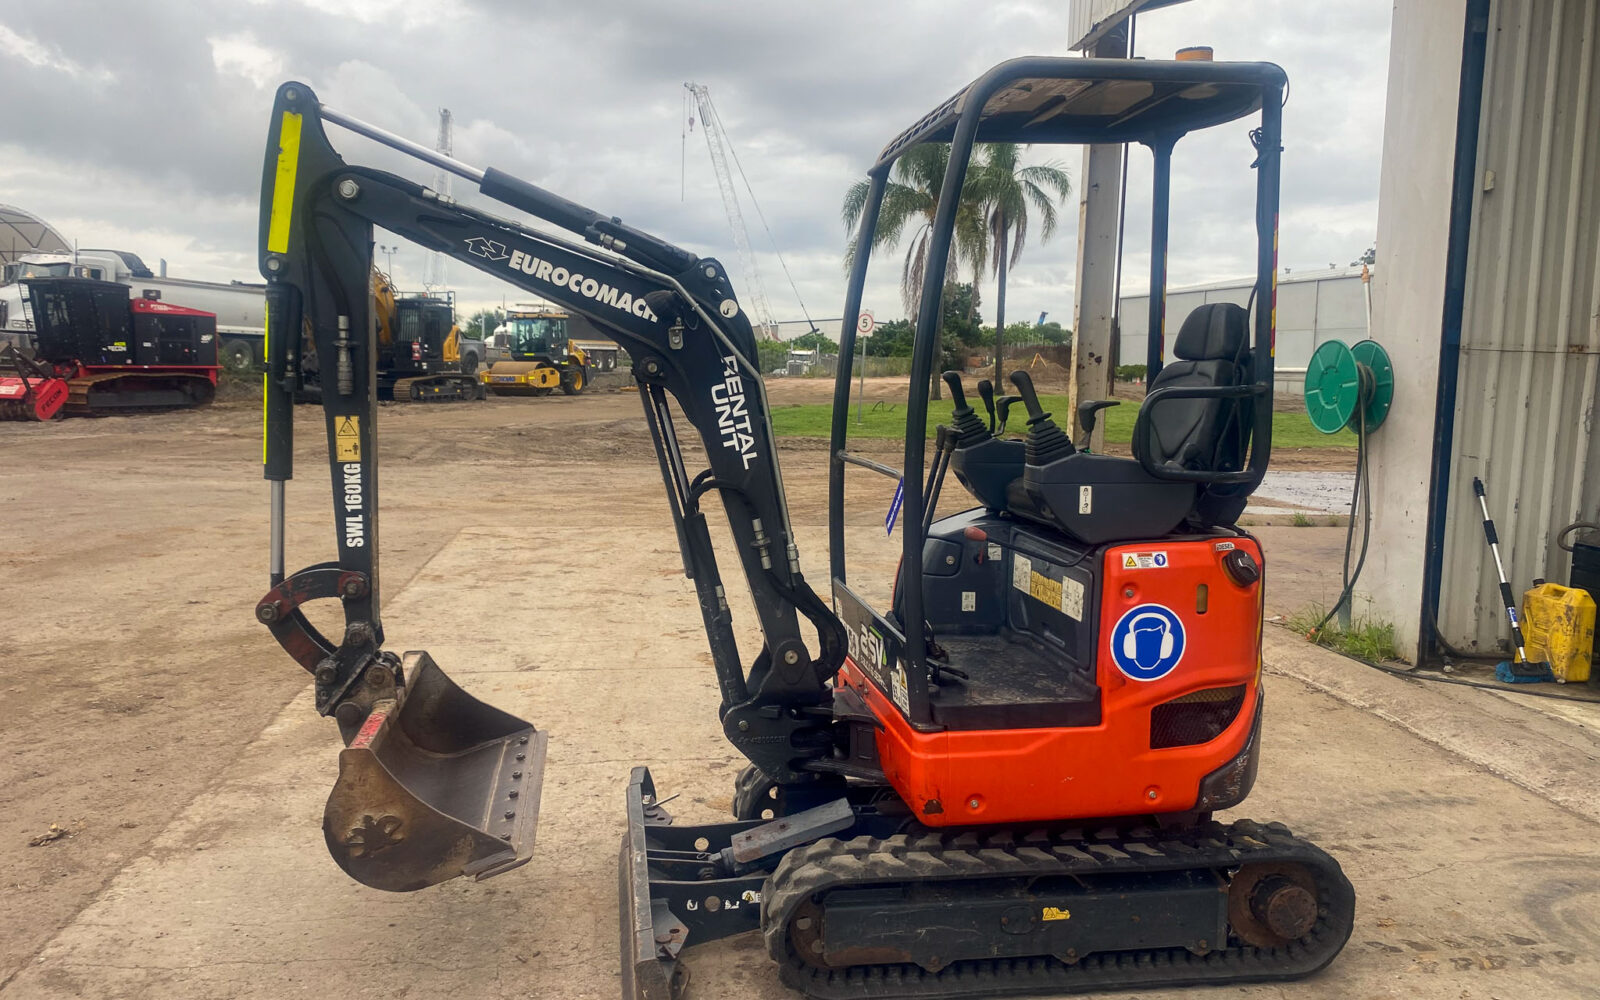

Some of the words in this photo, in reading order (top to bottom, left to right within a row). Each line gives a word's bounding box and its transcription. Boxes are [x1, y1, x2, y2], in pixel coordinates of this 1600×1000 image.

[862, 318, 868, 328] 5
[40, 388, 63, 412] FECON
[711, 383, 740, 452] UNIT
[720, 355, 758, 470] RENTAL
[343, 462, 363, 513] 160KG
[345, 514, 364, 548] SWL
